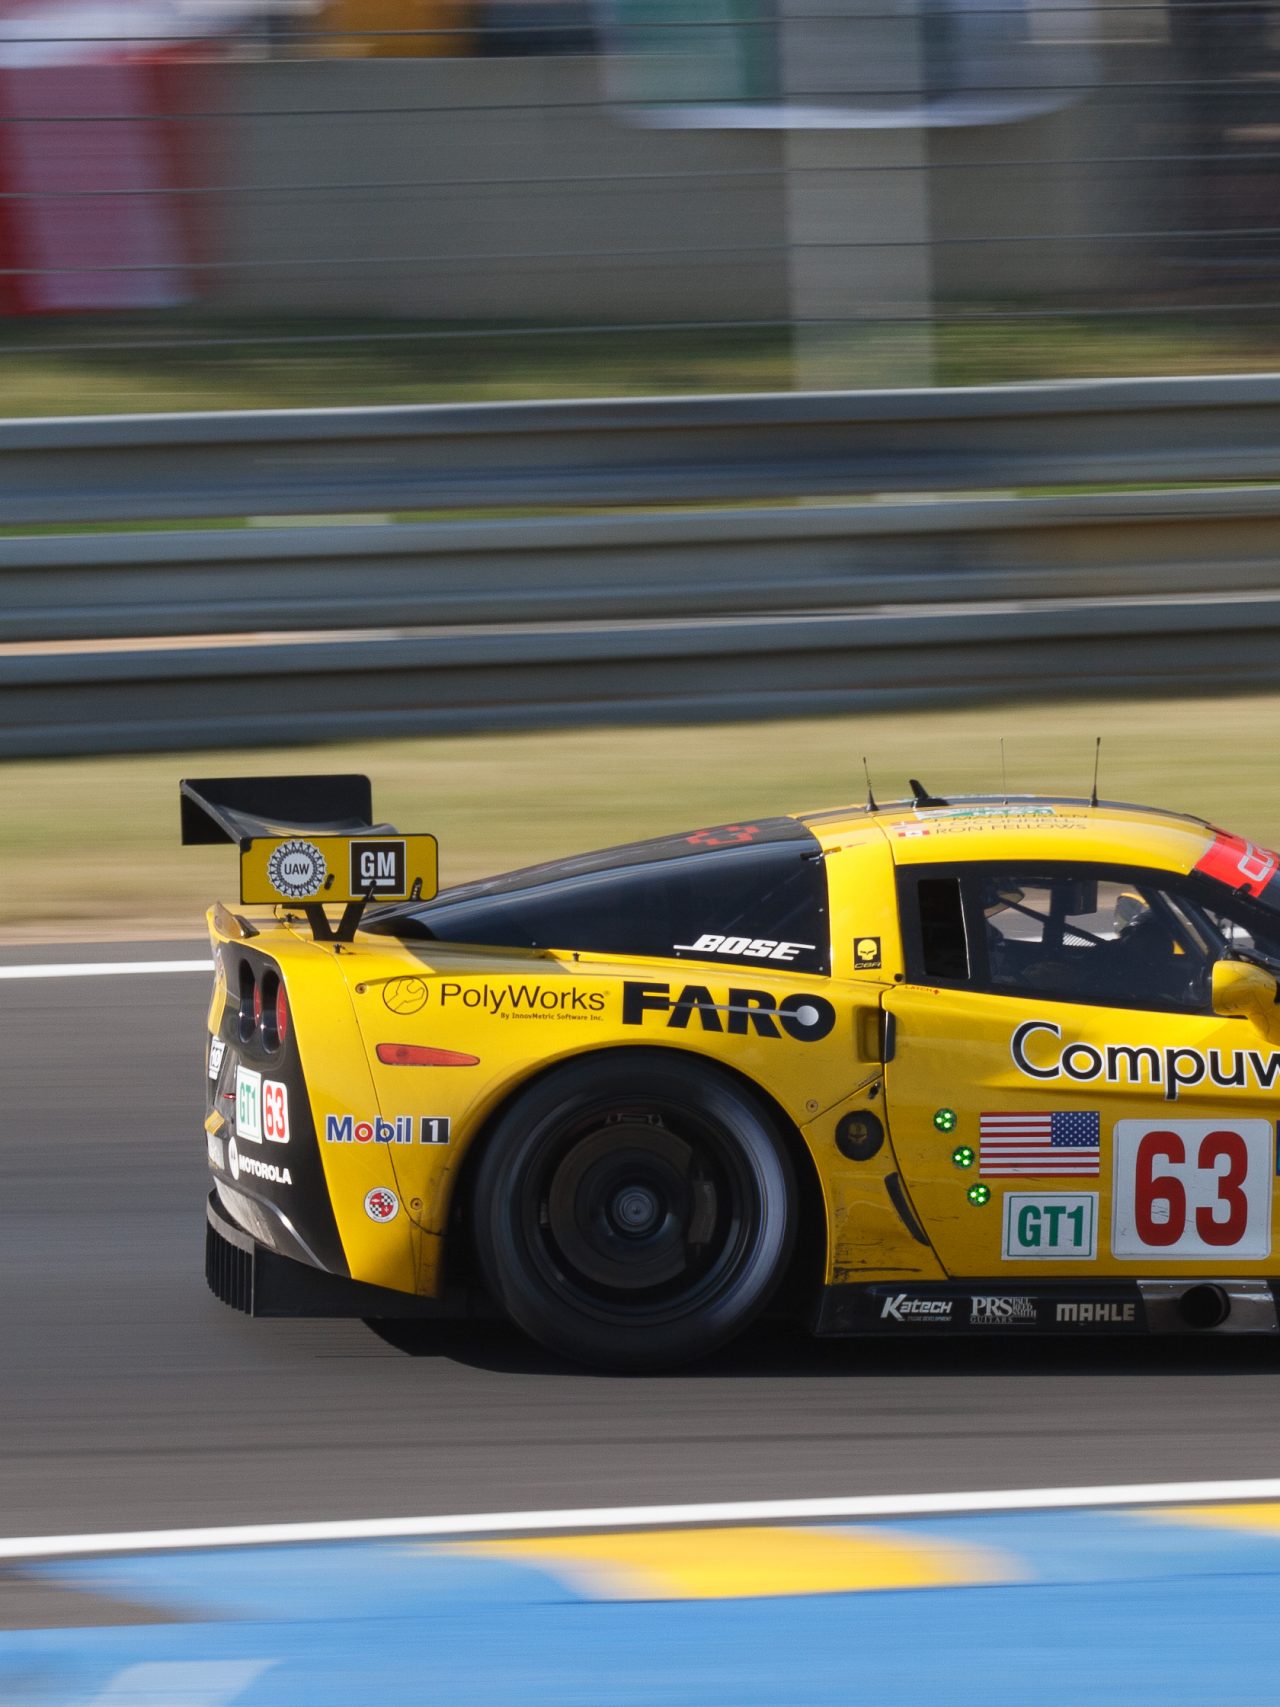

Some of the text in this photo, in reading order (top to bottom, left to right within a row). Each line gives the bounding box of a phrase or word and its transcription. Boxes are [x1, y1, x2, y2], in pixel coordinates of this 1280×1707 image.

[284, 863, 310, 875] UAW
[360, 851, 396, 877] GM
[673, 934, 815, 960] BOSE
[440, 983, 606, 1015] PolyWorks
[622, 980, 836, 1042] FARO
[557, 1013, 588, 1021] Software
[240, 1081, 257, 1128] GT1
[265, 1085, 286, 1139] 63
[326, 1116, 413, 1143] Mobil
[238, 1153, 293, 1185] MOTOROLA
[1134, 1130, 1249, 1247] 63
[1016, 1204, 1084, 1248] GT1
[970, 1295, 1013, 1317] PRS
[1056, 1303, 1135, 1322] MAHLE
